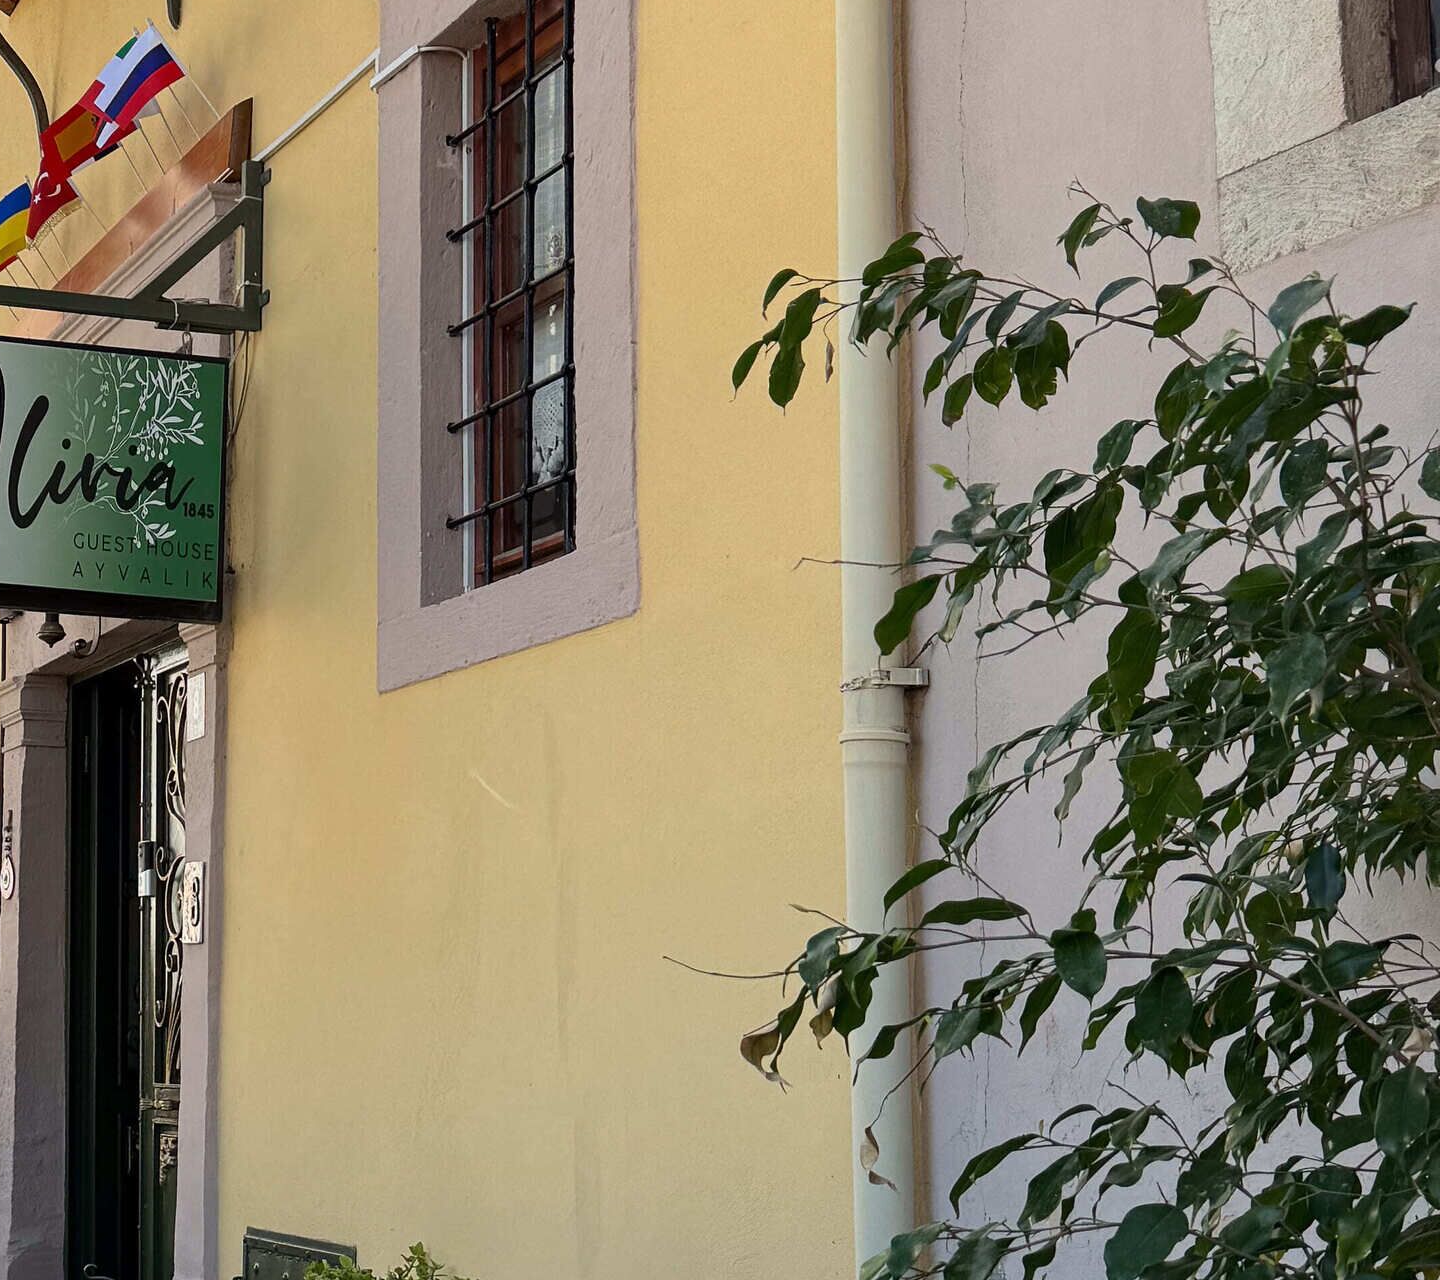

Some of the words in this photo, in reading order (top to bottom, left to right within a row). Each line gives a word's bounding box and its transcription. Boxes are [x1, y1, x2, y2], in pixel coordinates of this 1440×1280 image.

[182, 501, 215, 519] 1845
[73, 532, 137, 554] GUEST
[146, 540, 215, 561] HOUSE
[72, 560, 214, 590] AYVALIK
